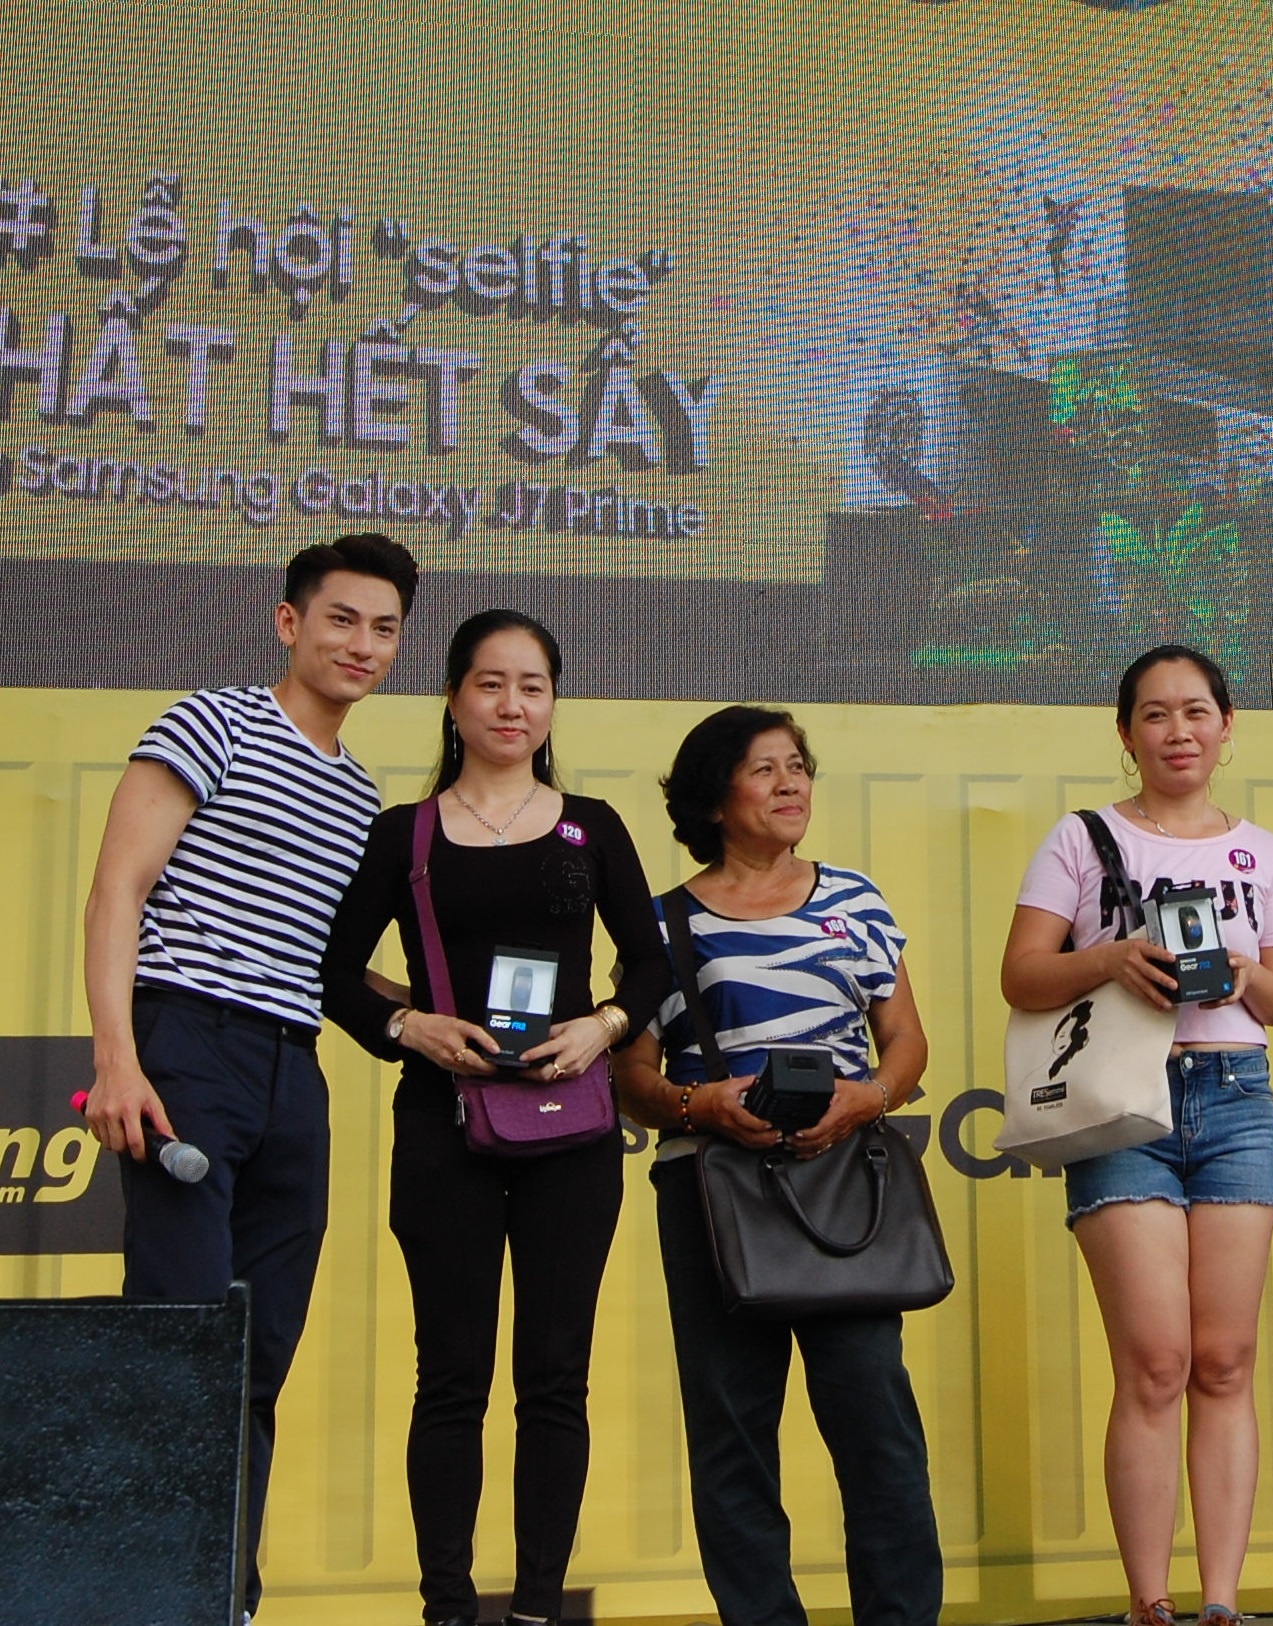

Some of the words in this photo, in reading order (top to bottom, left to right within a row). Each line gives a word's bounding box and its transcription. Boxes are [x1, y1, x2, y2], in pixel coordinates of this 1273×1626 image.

[215, 198, 354, 304] hội
[271, 302, 482, 448] HẾT
[19, 446, 279, 524] Samsung
[293, 466, 481, 538] Galaxy
[500, 481, 551, 526] J7
[565, 485, 706, 538] Prime
[561, 823, 583, 841] 120
